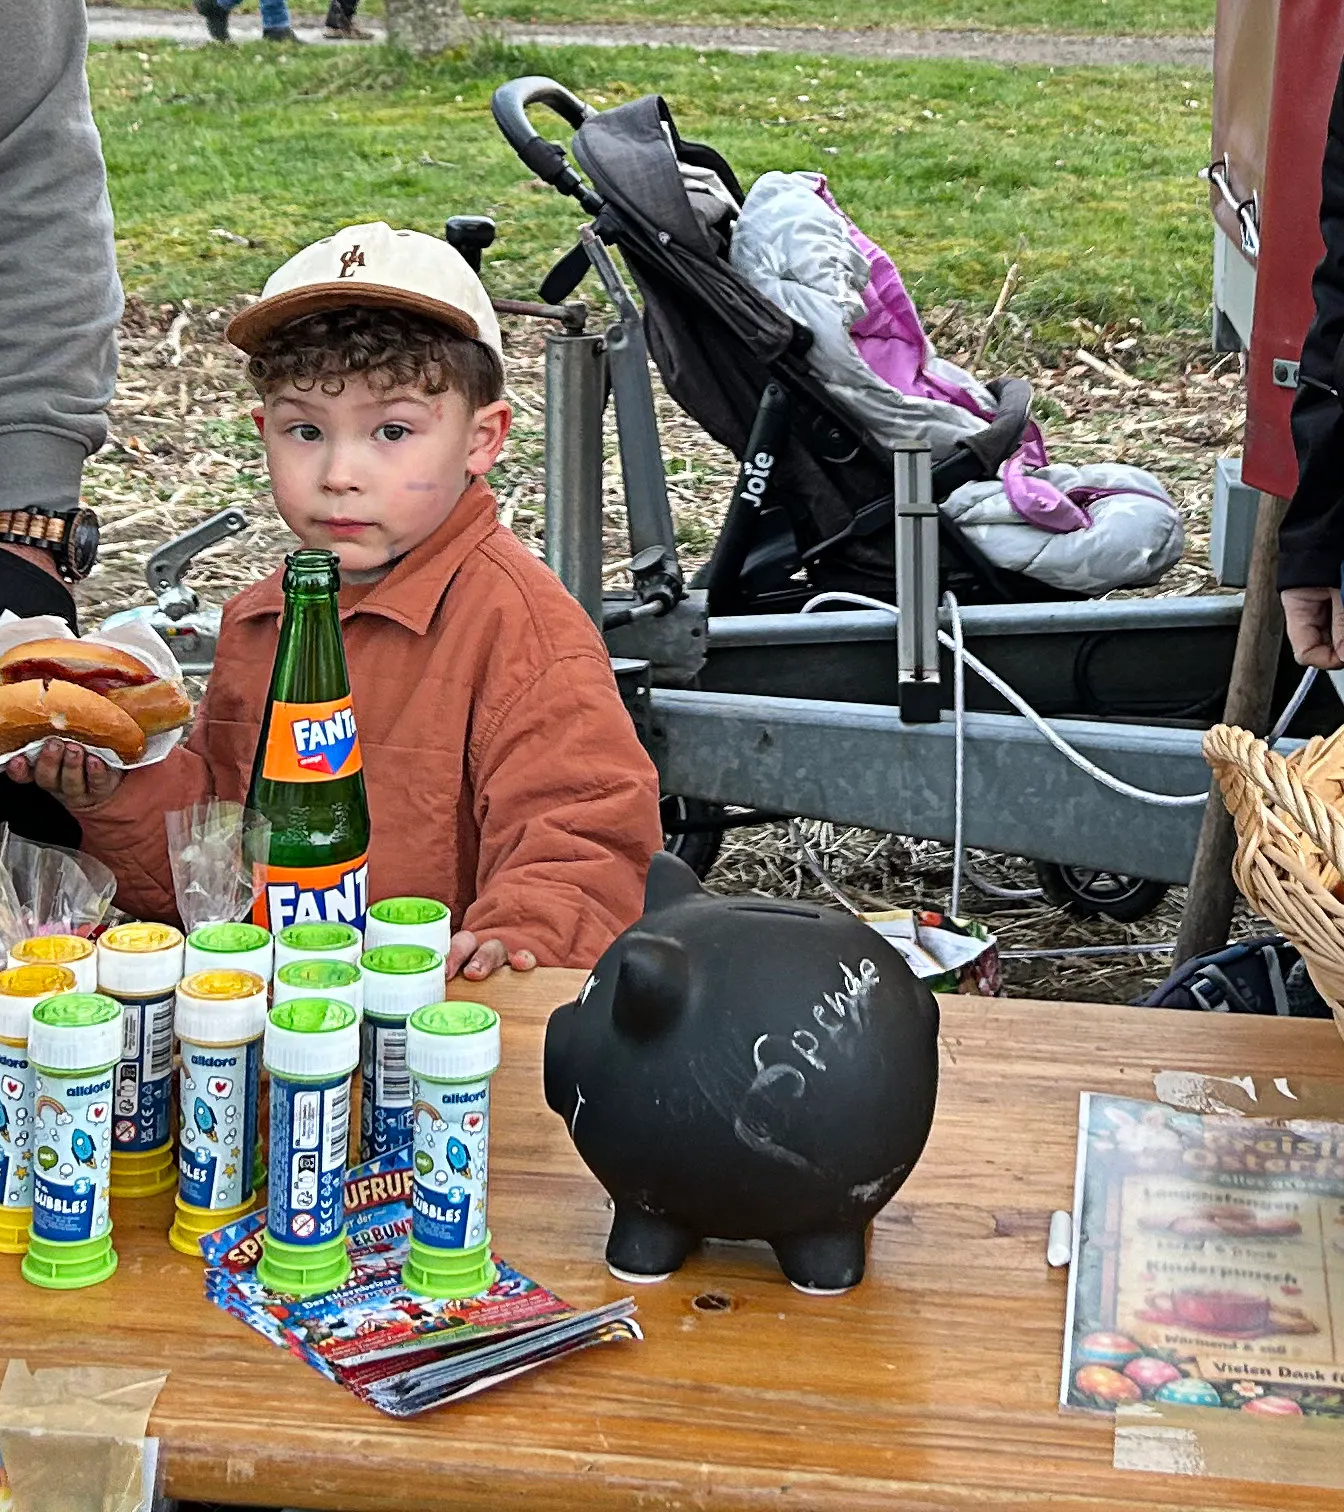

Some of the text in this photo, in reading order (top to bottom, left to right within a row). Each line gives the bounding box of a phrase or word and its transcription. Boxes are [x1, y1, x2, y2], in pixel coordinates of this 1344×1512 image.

[751, 958, 882, 1099] Spende
[191, 1054, 237, 1067] alldoro
[66, 1079, 111, 1097] alldoro
[1212, 1361, 1273, 1379] Vielen
[1278, 1367, 1325, 1382] Dank
